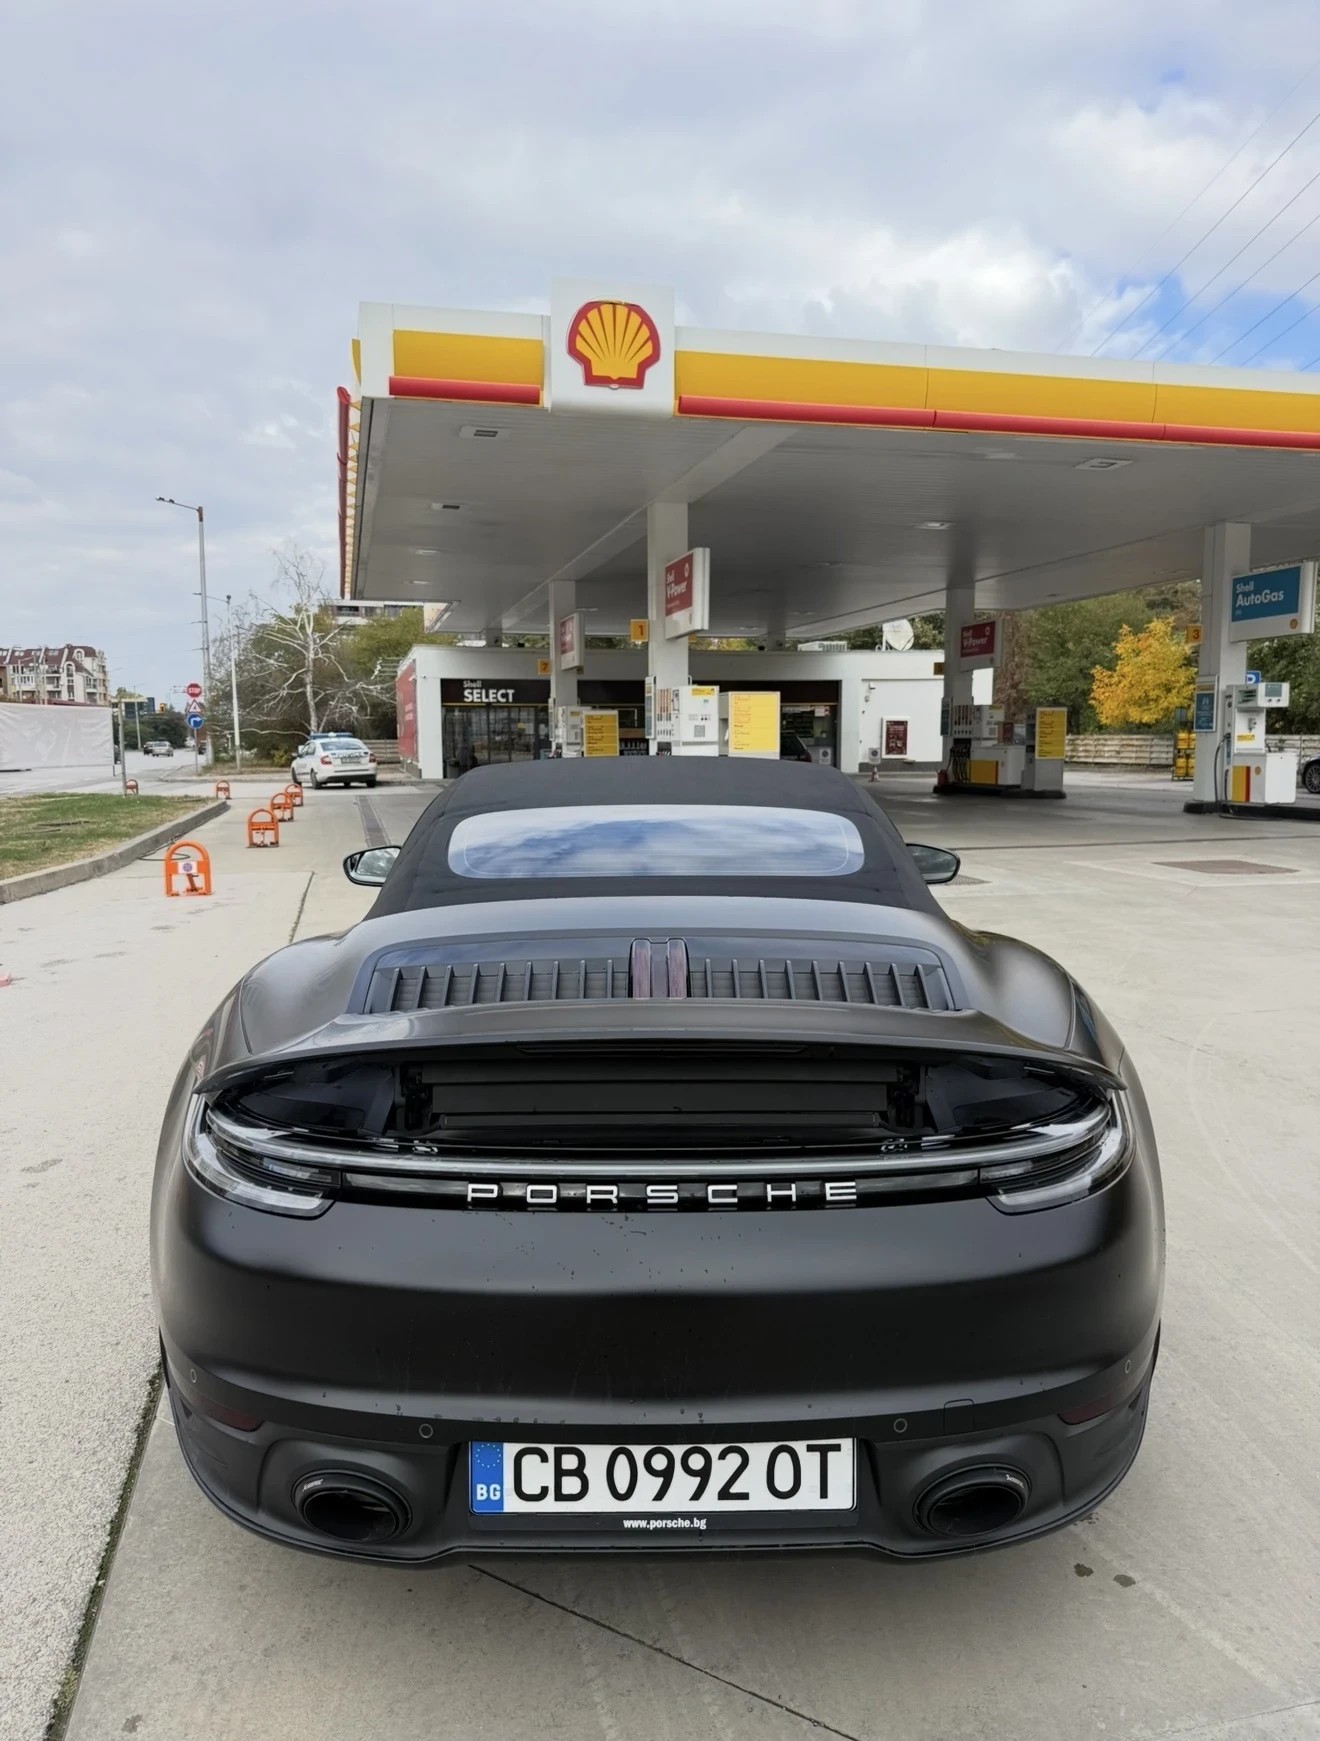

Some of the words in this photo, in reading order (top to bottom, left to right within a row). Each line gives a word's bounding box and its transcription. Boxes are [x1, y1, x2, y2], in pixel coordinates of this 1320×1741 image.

[666, 581, 688, 600] V-Power
[1236, 581, 1254, 593] Shell
[1235, 589, 1285, 608] AutoGas
[638, 624, 644, 636] 1
[1192, 629, 1201, 640] 3
[963, 637, 988, 647] V-Power
[543, 662, 549, 671] 7
[463, 680, 482, 688] Shell
[463, 689, 515, 703] SELECT
[466, 1180, 858, 1205] PORSCHE
[513, 1446, 590, 1502] CB
[606, 1445, 750, 1502] 0992
[765, 1443, 842, 1500] OT
[476, 1483, 502, 1501] BG
[623, 1517, 708, 1531] www.porsche.bg
